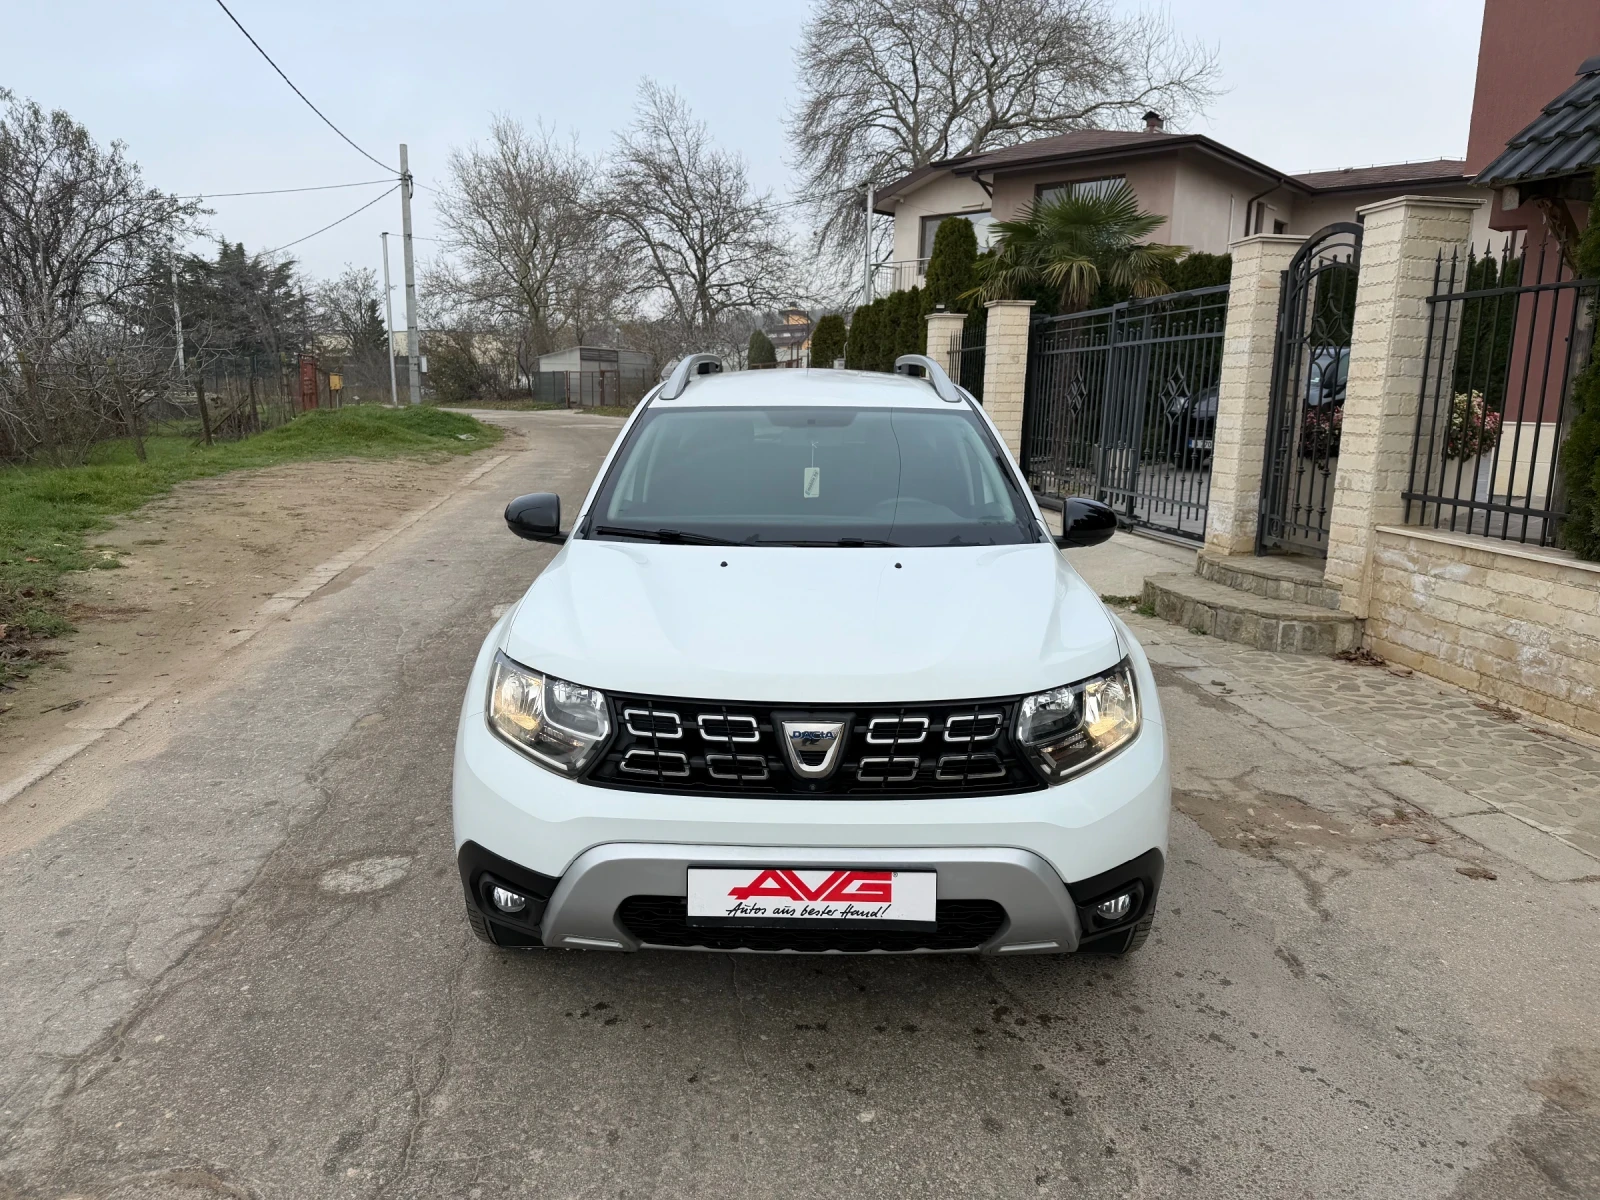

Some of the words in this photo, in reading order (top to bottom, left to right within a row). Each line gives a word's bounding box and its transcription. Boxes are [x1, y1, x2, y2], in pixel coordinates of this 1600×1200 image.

[792, 730, 834, 739] DACIA
[725, 901, 767, 917] Autos
[800, 904, 838, 917] bester
[840, 903, 892, 919] Hand!
